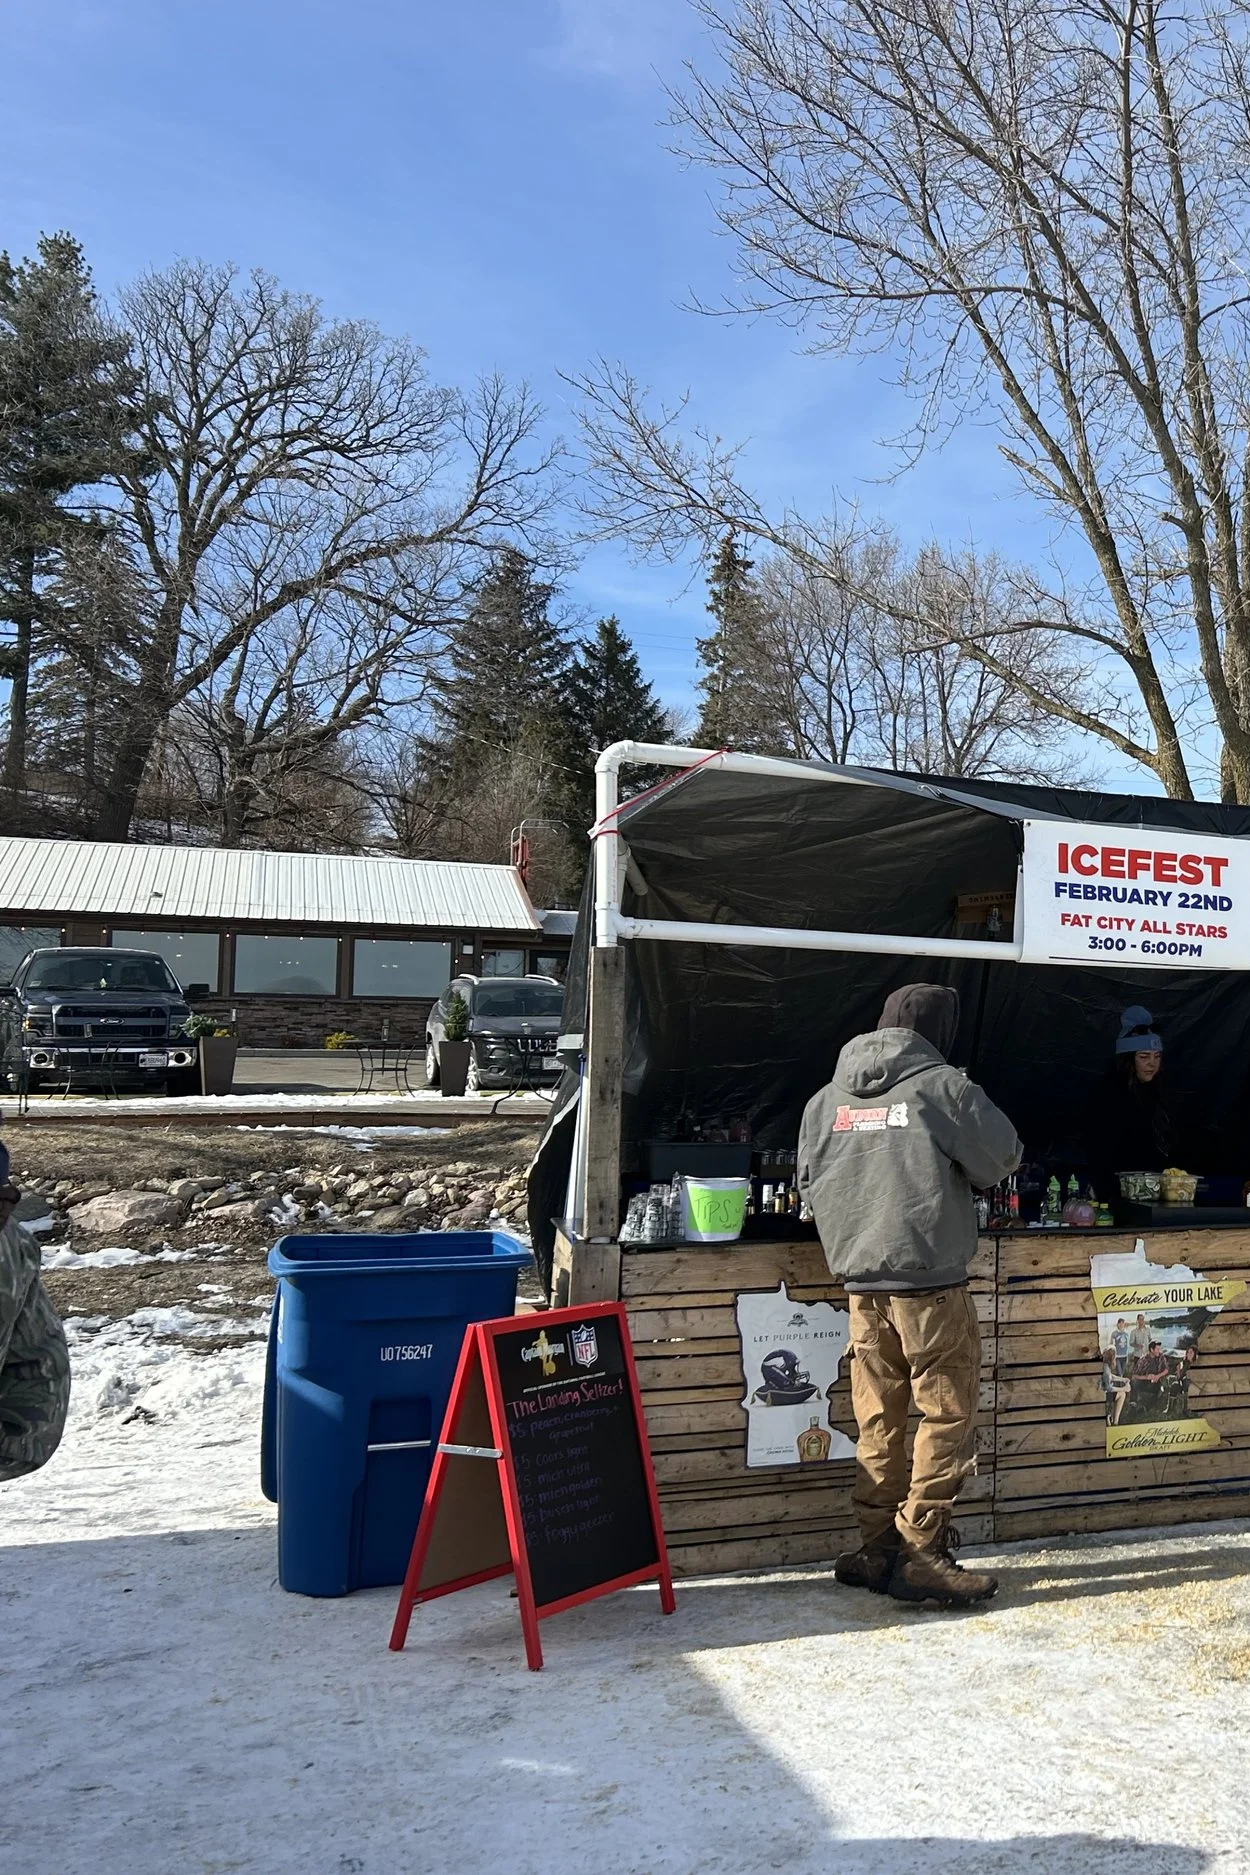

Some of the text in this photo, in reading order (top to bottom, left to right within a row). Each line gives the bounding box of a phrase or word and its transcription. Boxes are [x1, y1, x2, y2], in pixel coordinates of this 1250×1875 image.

[1057, 842, 1229, 888] ICEFEST
[1054, 881, 1233, 912] FEBRUARY 22ND
[1060, 912, 1228, 938] FAT CITY ALL STARS
[1088, 936, 1126, 952] 3:00
[1140, 939, 1203, 957] 6:00PM
[696, 1195, 731, 1223] TIPS
[1102, 1286, 1223, 1308] Celebrate YOUR LAKE
[753, 1331, 841, 1343] LET PURPLE REIGN
[577, 1342, 595, 1360] NFL
[506, 1400, 537, 1419] The
[538, 1390, 580, 1411] Landing
[580, 1378, 624, 1402] Seltzer!
[1112, 1432, 1207, 1451] Golden LIGHT
